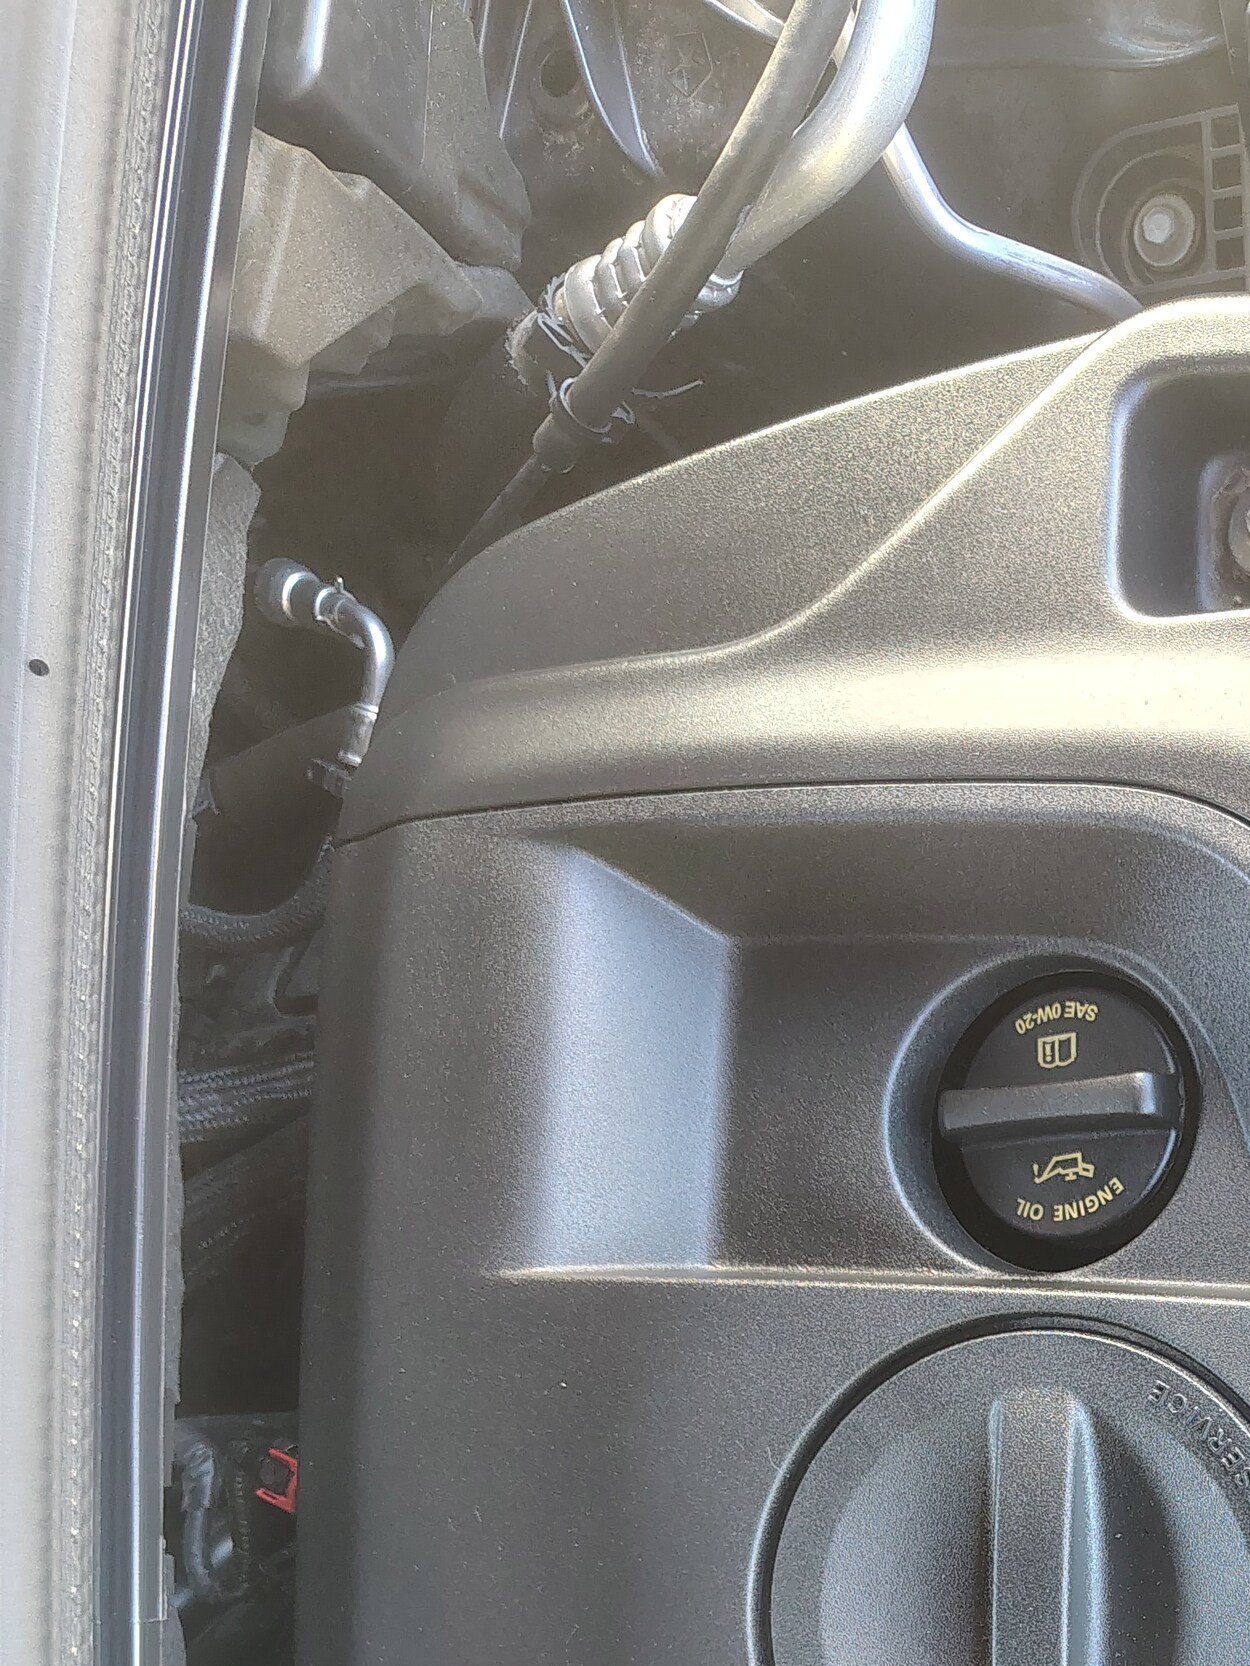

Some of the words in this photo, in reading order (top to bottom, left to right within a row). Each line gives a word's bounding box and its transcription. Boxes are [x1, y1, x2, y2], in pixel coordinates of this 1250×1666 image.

[1015, 1004, 1062, 1035] 0W-20
[1064, 1000, 1099, 1022] SAE
[1015, 1197, 1045, 1221] OIL
[1053, 1176, 1125, 1222] ENGINE
